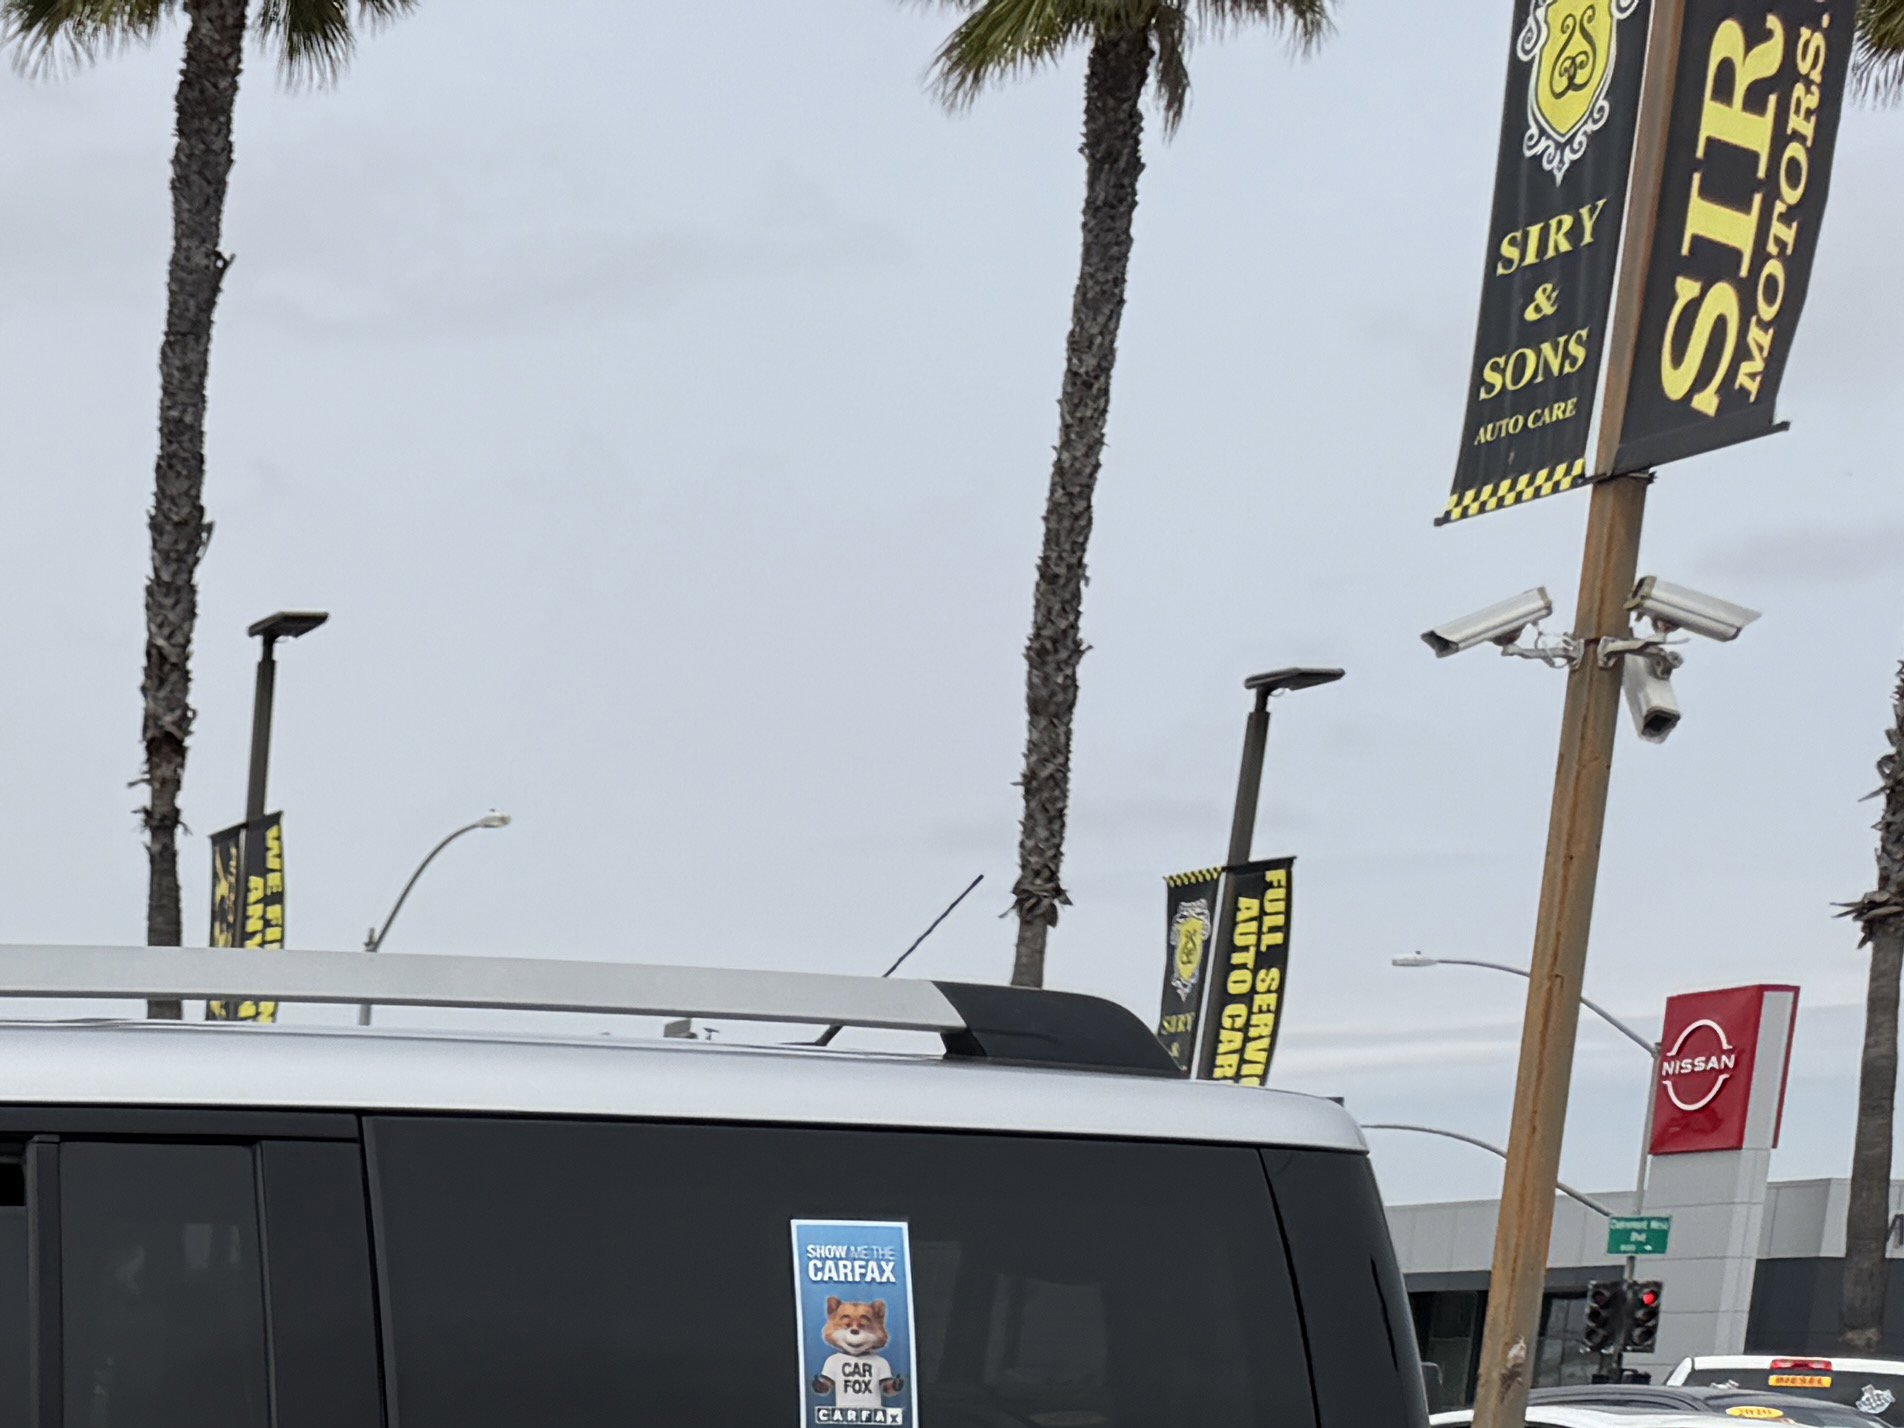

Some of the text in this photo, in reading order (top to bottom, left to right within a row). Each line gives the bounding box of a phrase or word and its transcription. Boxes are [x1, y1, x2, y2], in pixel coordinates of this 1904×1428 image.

[1733, 0, 1832, 403] MOTORS.
[1496, 199, 1607, 277] SIRY
[1523, 282, 1560, 322] &
[1478, 327, 1588, 401] SONS
[1474, 396, 1577, 446] AUTO CARE
[1260, 869, 1286, 952] FULL
[1212, 897, 1260, 1084] AUTO CAR
[1661, 1054, 1735, 1076] NISSAN
[806, 1244, 896, 1260] SHOW ME THE
[808, 1260, 896, 1282] CARFAX
[842, 1363, 872, 1378] CAR
[843, 1380, 872, 1394] FOX
[817, 1408, 901, 1424] CARFAX
